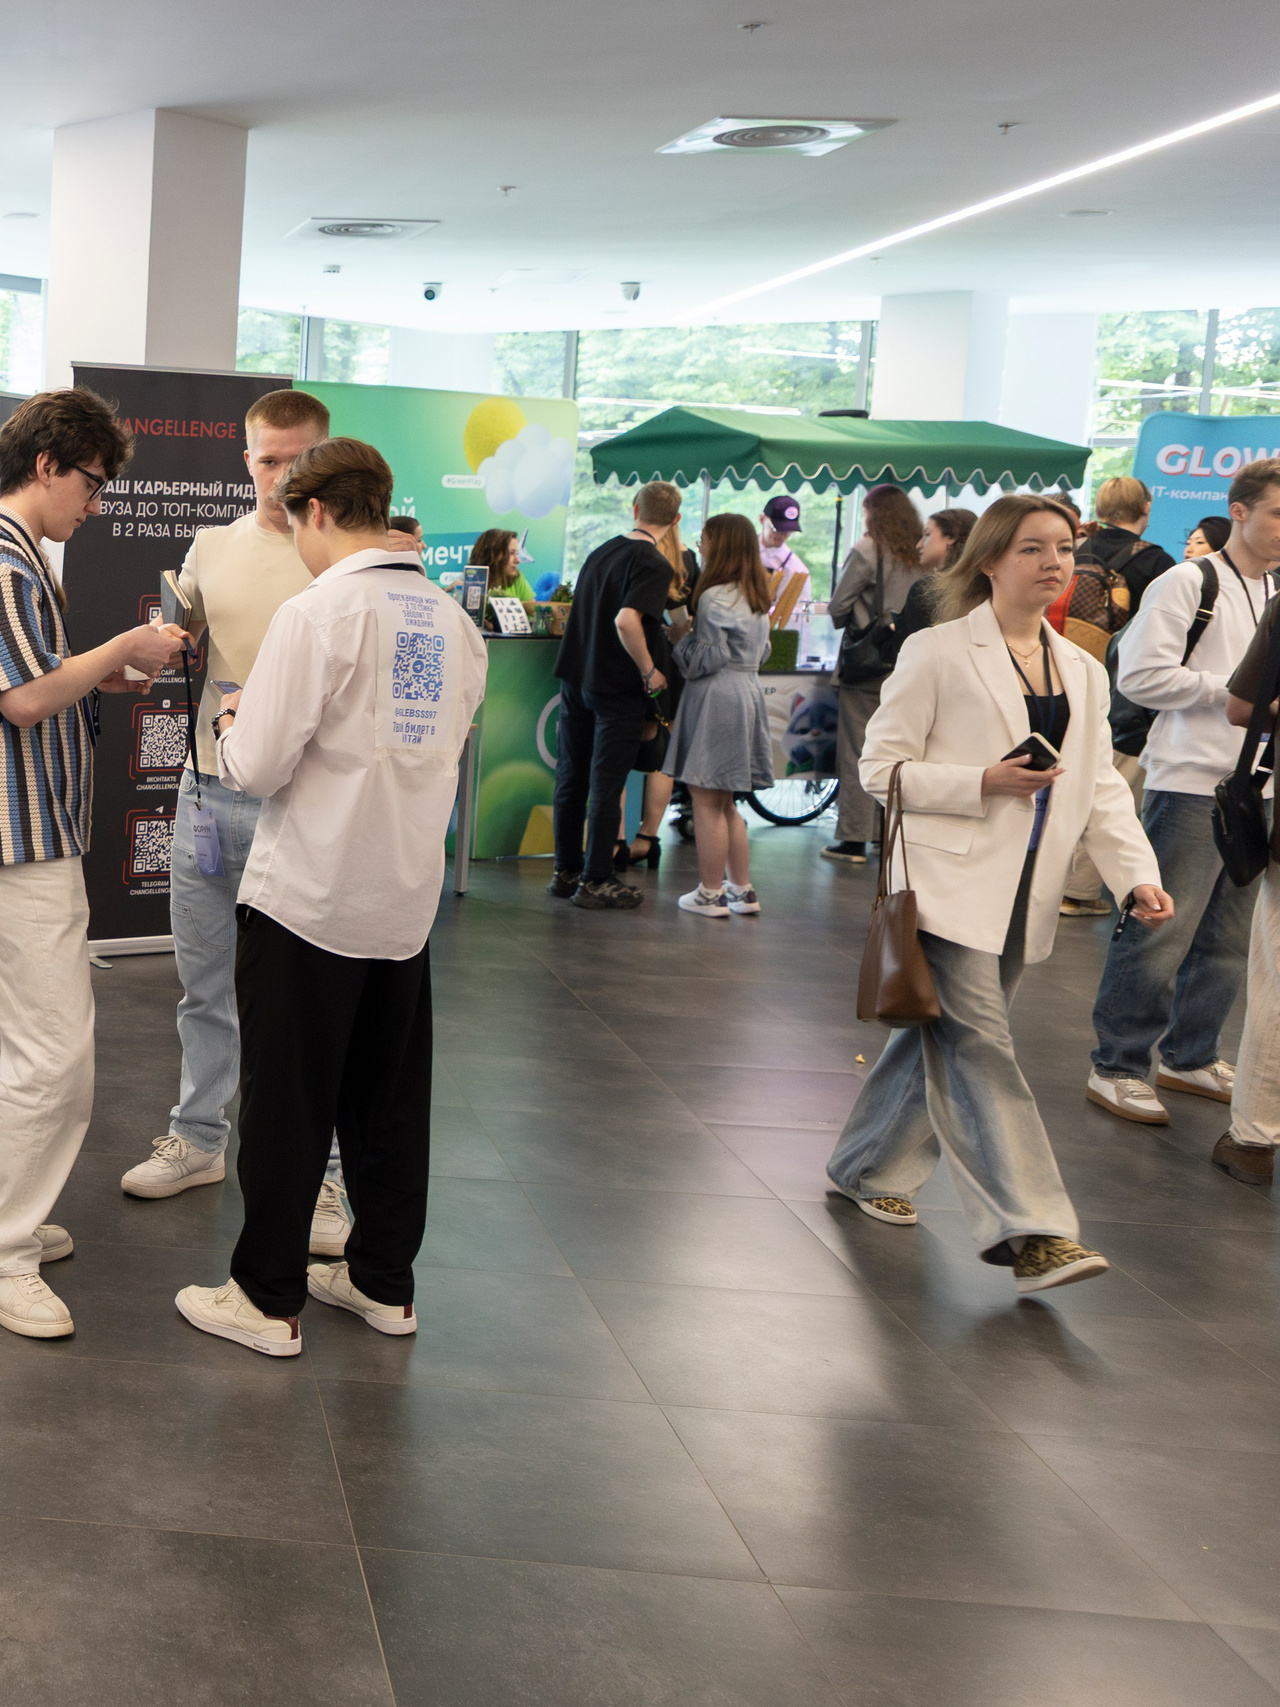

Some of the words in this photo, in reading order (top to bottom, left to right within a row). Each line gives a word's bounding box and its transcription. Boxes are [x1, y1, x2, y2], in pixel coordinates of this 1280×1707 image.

[102, 479, 130, 494] АШ
[133, 480, 223, 497] КАРЬЕРНЫЙ
[100, 500, 133, 515] ВУЗА
[136, 501, 158, 517] ДО
[162, 502, 256, 518] ТОП-КОМПАН
[112, 522, 122, 537] В
[124, 522, 134, 537] 2
[137, 523, 171, 538] РАЗА
[420, 544, 474, 566] мечт
[153, 676, 186, 684] NGELLENGE
[405, 722, 430, 735] билет
[146, 775, 177, 783] ВКОНТАКТЕ
